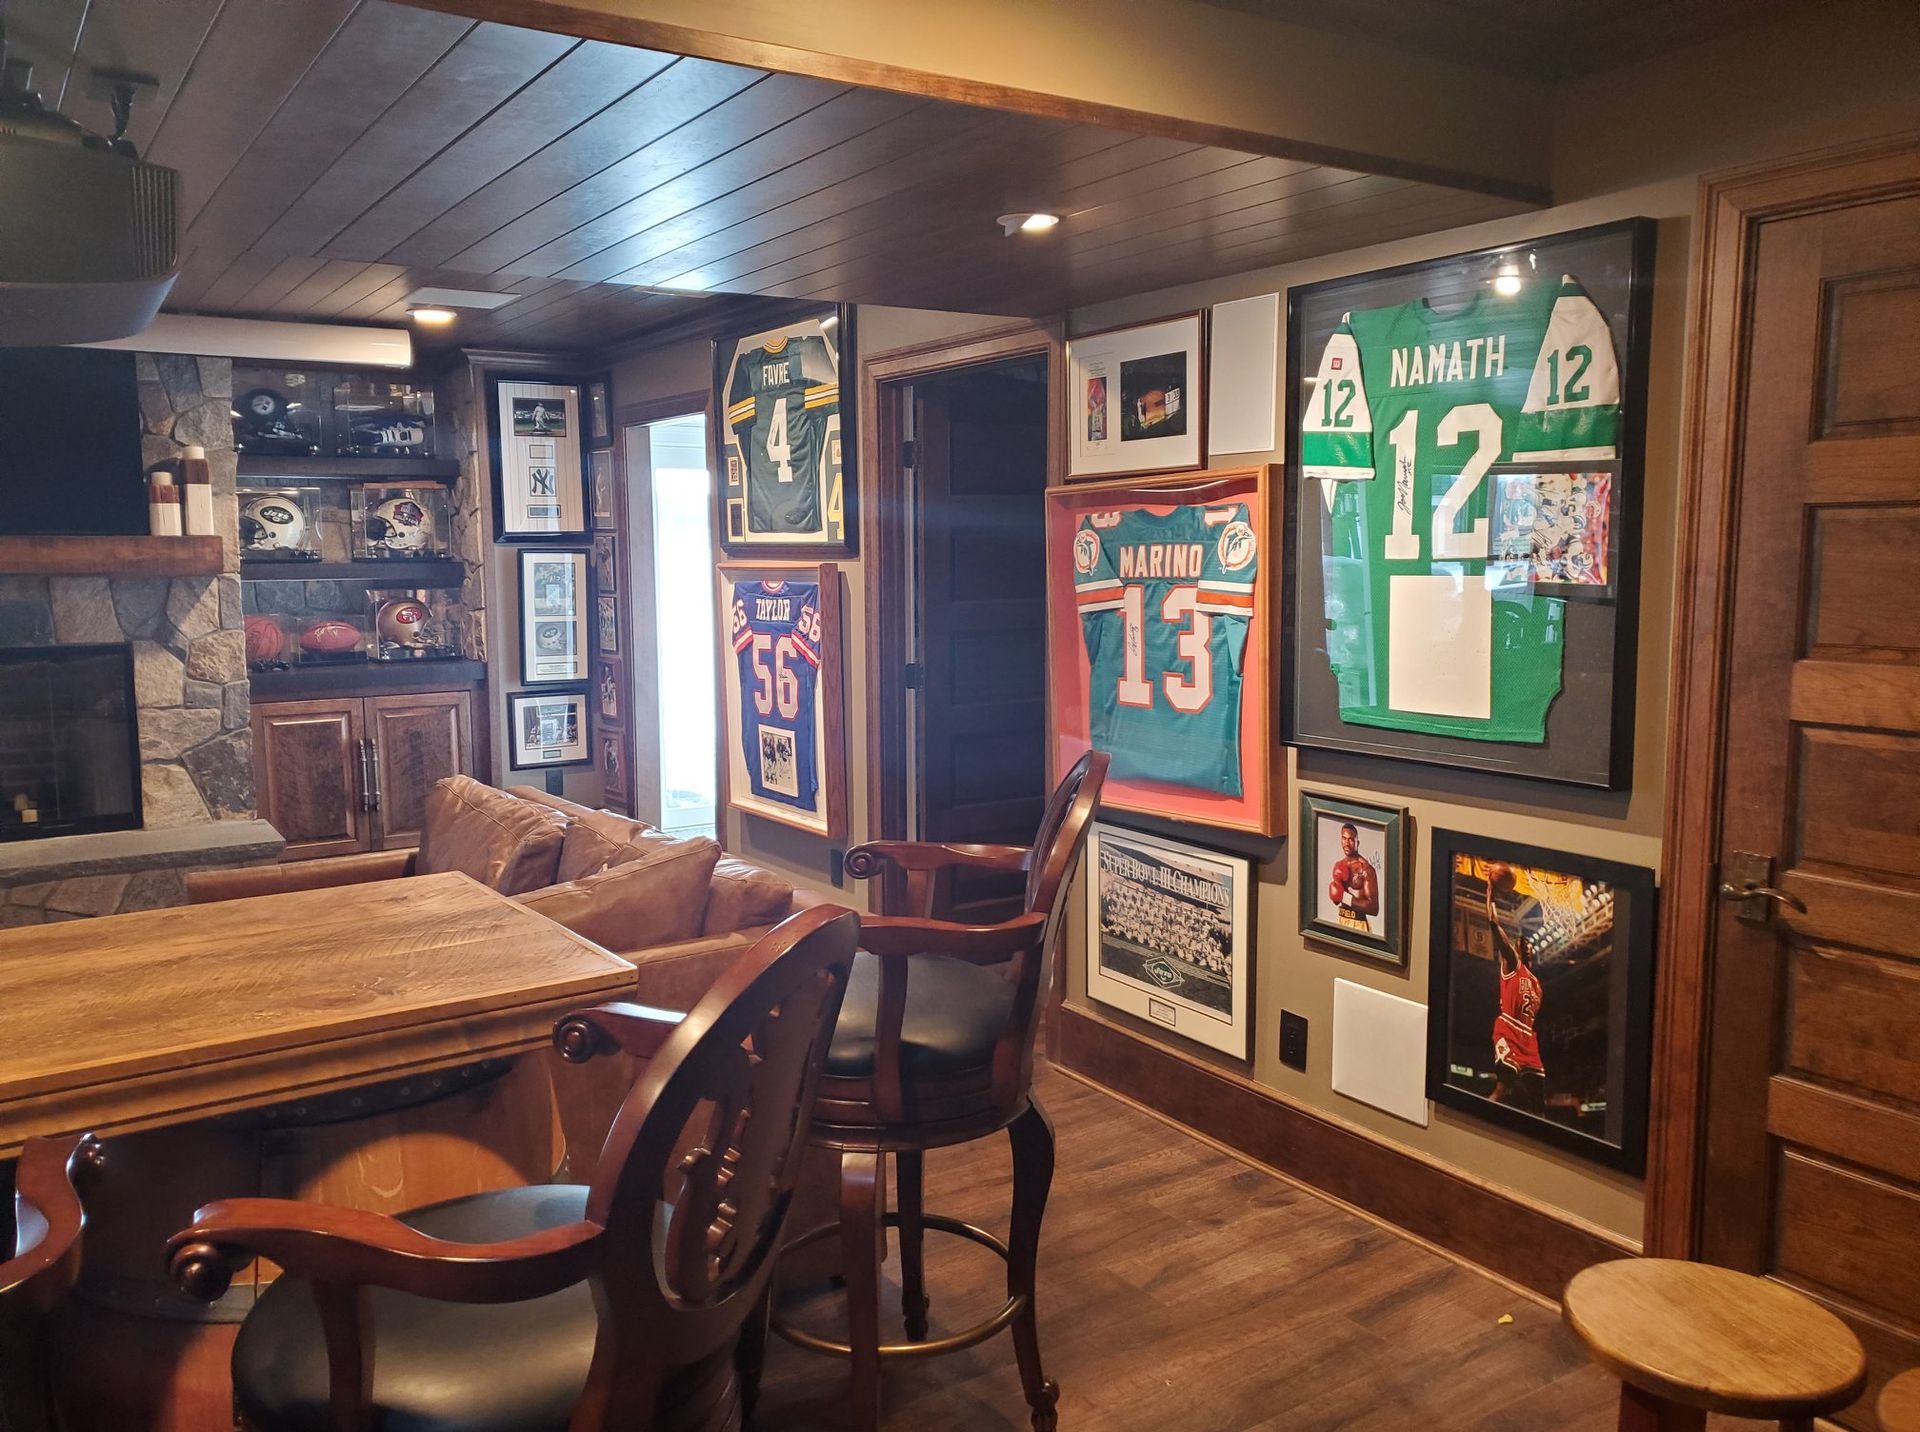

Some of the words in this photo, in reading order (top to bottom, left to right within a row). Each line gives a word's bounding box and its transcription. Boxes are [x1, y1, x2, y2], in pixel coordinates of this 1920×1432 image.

[762, 361, 790, 386] FAVRE
[1389, 335, 1506, 388] NAMATH
[1547, 345, 1593, 405] 12
[1321, 378, 1357, 428] 12
[766, 398, 793, 483] 4
[1384, 402, 1503, 560] 12
[1119, 544, 1203, 578] MARINO
[755, 598, 791, 621] TAYLOR
[798, 604, 821, 643] 56
[1117, 583, 1213, 714] 13
[752, 632, 799, 720] 56
[1103, 852, 1130, 877] SUPER
[1130, 858, 1157, 886] BOWL
[1159, 865, 1171, 891] III
[1171, 870, 1230, 908] CHAMPIONS
